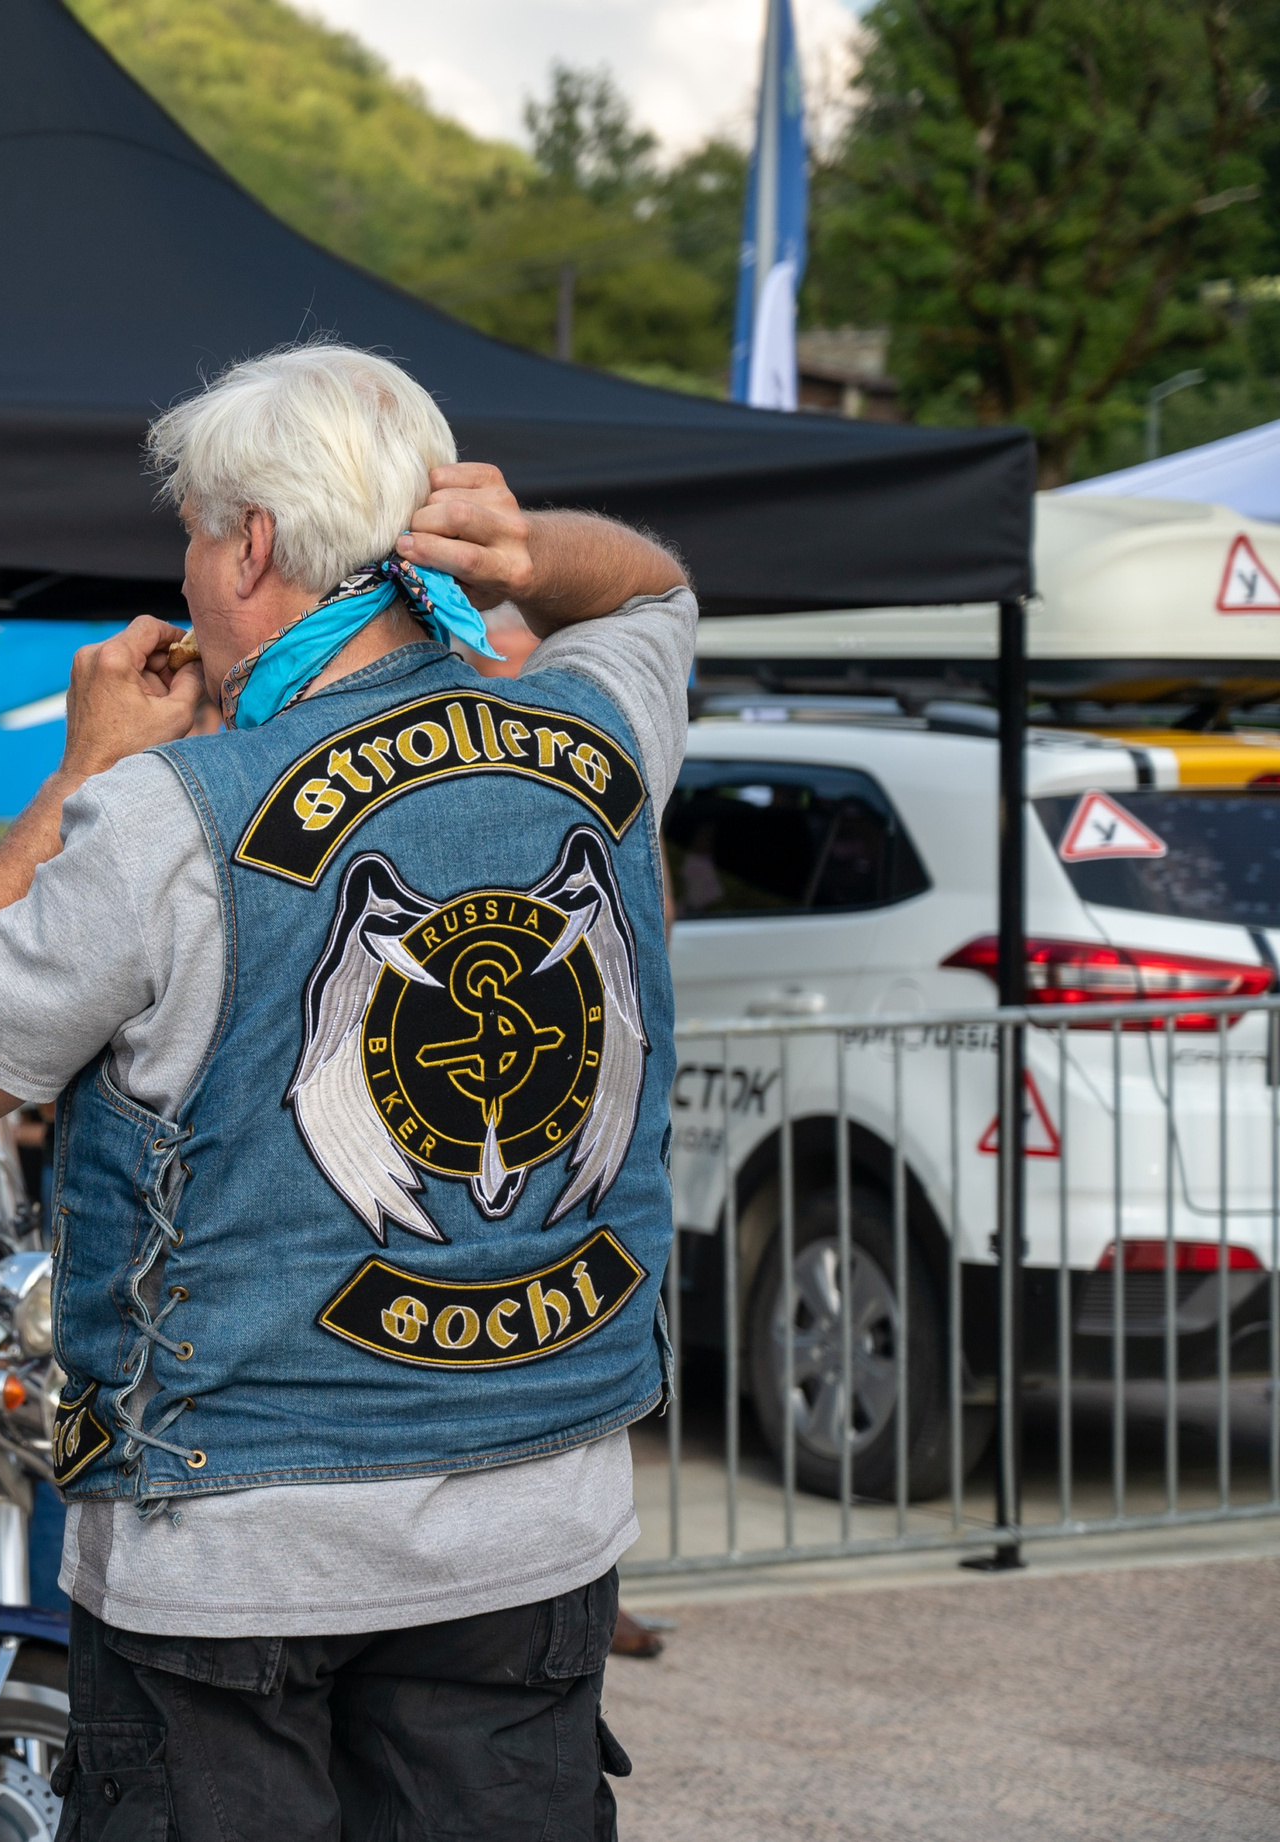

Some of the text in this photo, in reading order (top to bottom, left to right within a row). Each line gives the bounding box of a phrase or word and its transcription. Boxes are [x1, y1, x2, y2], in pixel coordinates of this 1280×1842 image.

[422, 900, 539, 949] RUSSIA
[368, 1004, 602, 1158] BIKER CLUB
